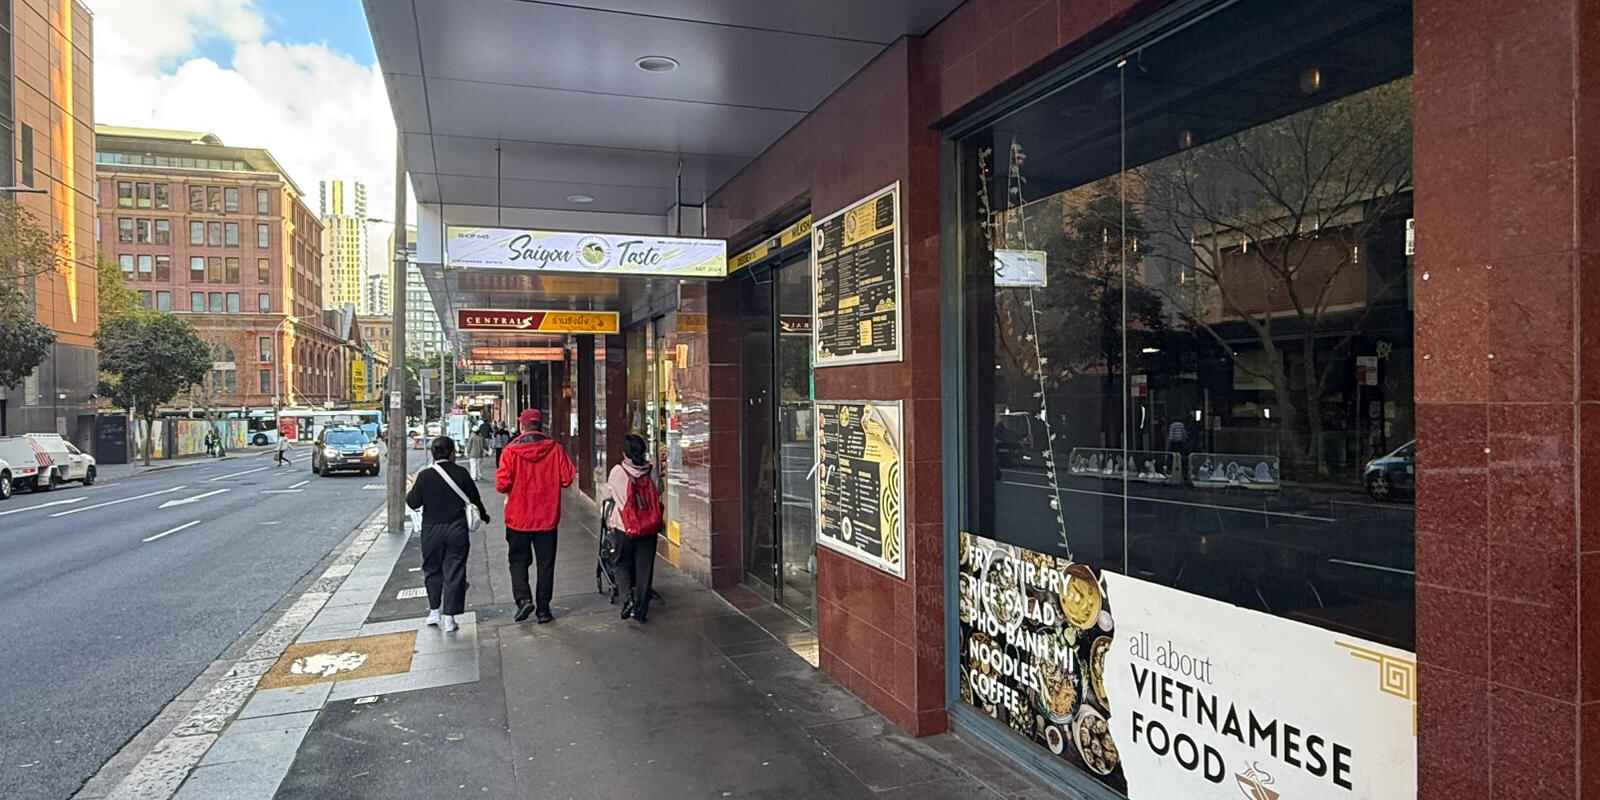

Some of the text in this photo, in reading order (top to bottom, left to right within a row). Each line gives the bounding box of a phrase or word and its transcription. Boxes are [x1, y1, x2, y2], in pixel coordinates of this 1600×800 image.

[508, 234, 573, 268] Saigon
[617, 240, 662, 266] Taste
[466, 316, 522, 325] CENTRAL
[969, 546, 1072, 595] FRY STIR FRY
[969, 575, 1055, 625] RICE SALAD
[969, 608, 999, 637] PHO
[1006, 622, 1048, 656] BANH
[969, 637, 1039, 688] NOODLES
[1129, 631, 1213, 685] all about
[970, 669, 1019, 710] COFFEE
[1130, 662, 1352, 791] VIETNAMESE
[1132, 710, 1226, 784] FOOD
